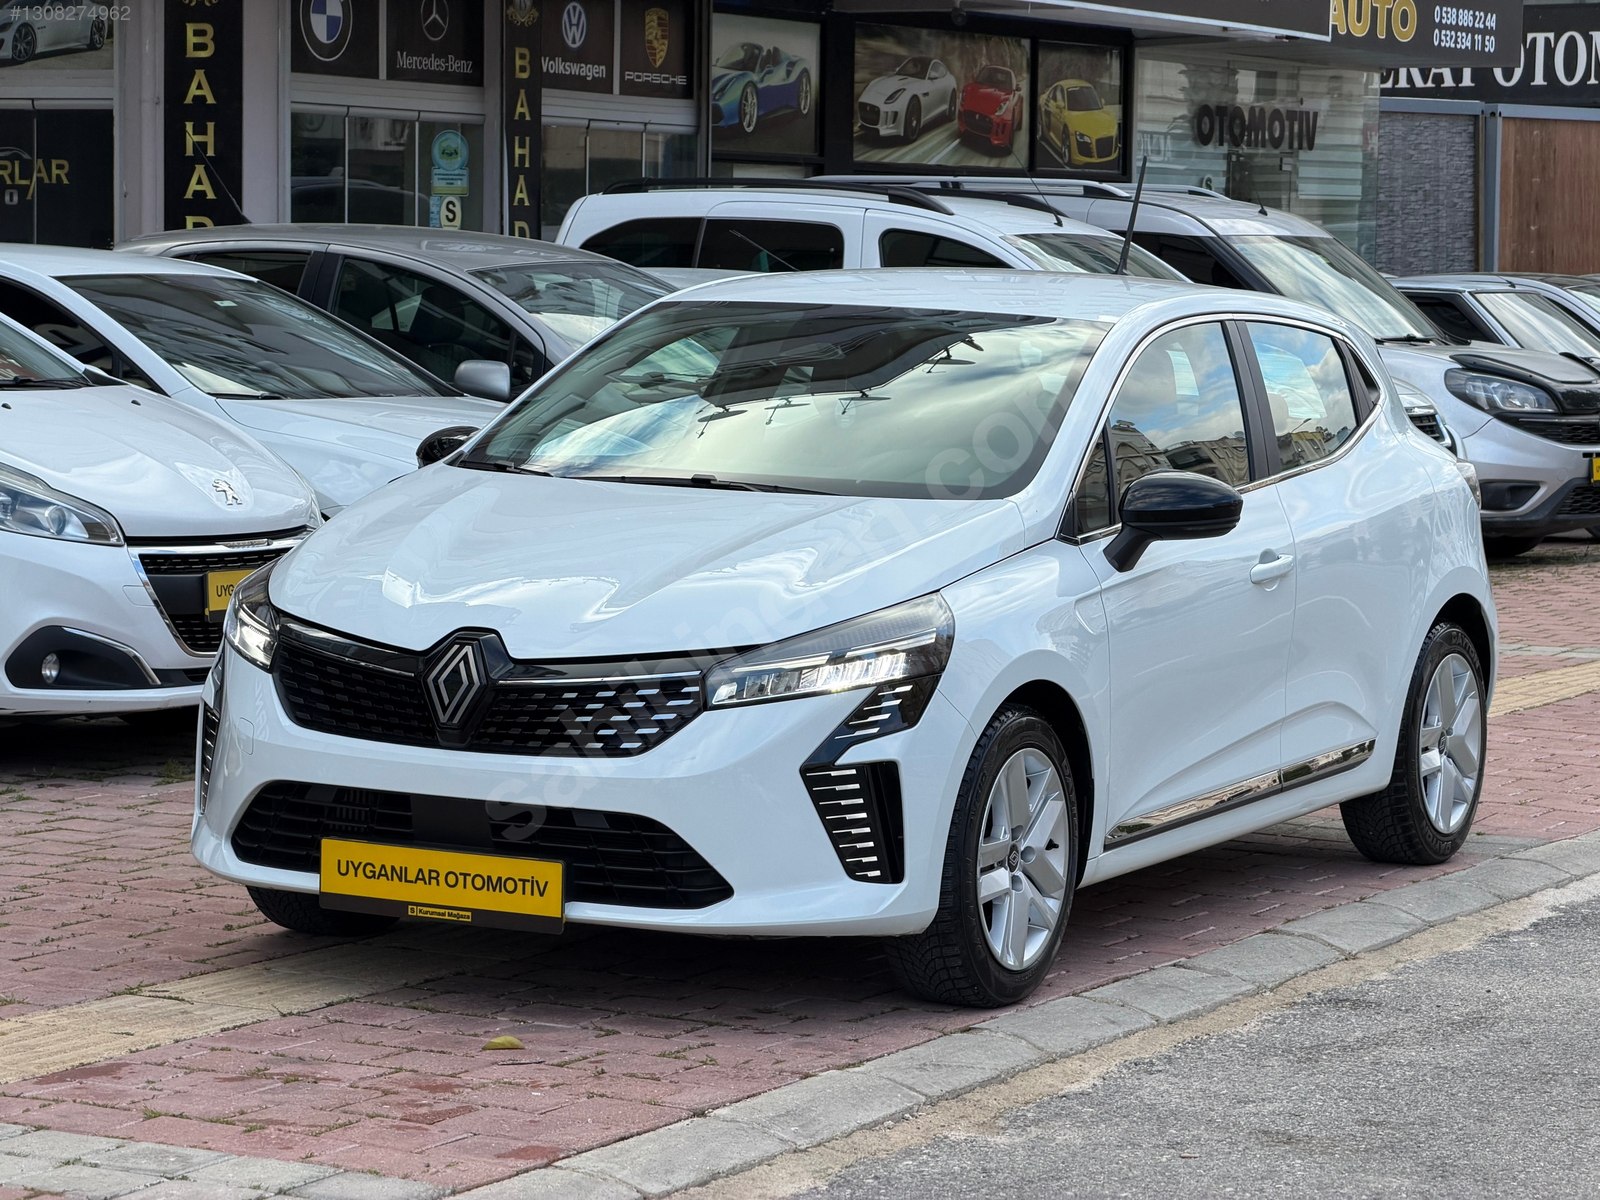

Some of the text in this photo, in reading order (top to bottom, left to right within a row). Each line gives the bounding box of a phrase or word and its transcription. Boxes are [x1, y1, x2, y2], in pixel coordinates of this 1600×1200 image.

[1434, 5, 1496, 30] 0 538 886 22 44
[1433, 28, 1495, 53] 0 532 334 11 50
[396, 51, 473, 75] Mercedes-Benz
[541, 56, 606, 80] Volkswagen
[624, 71, 688, 86] PORSCHE
[1196, 97, 1319, 151] OTOMOTİV
[445, 200, 457, 223] S
[337, 859, 549, 898] UYGANLAR OTOMOTİV
